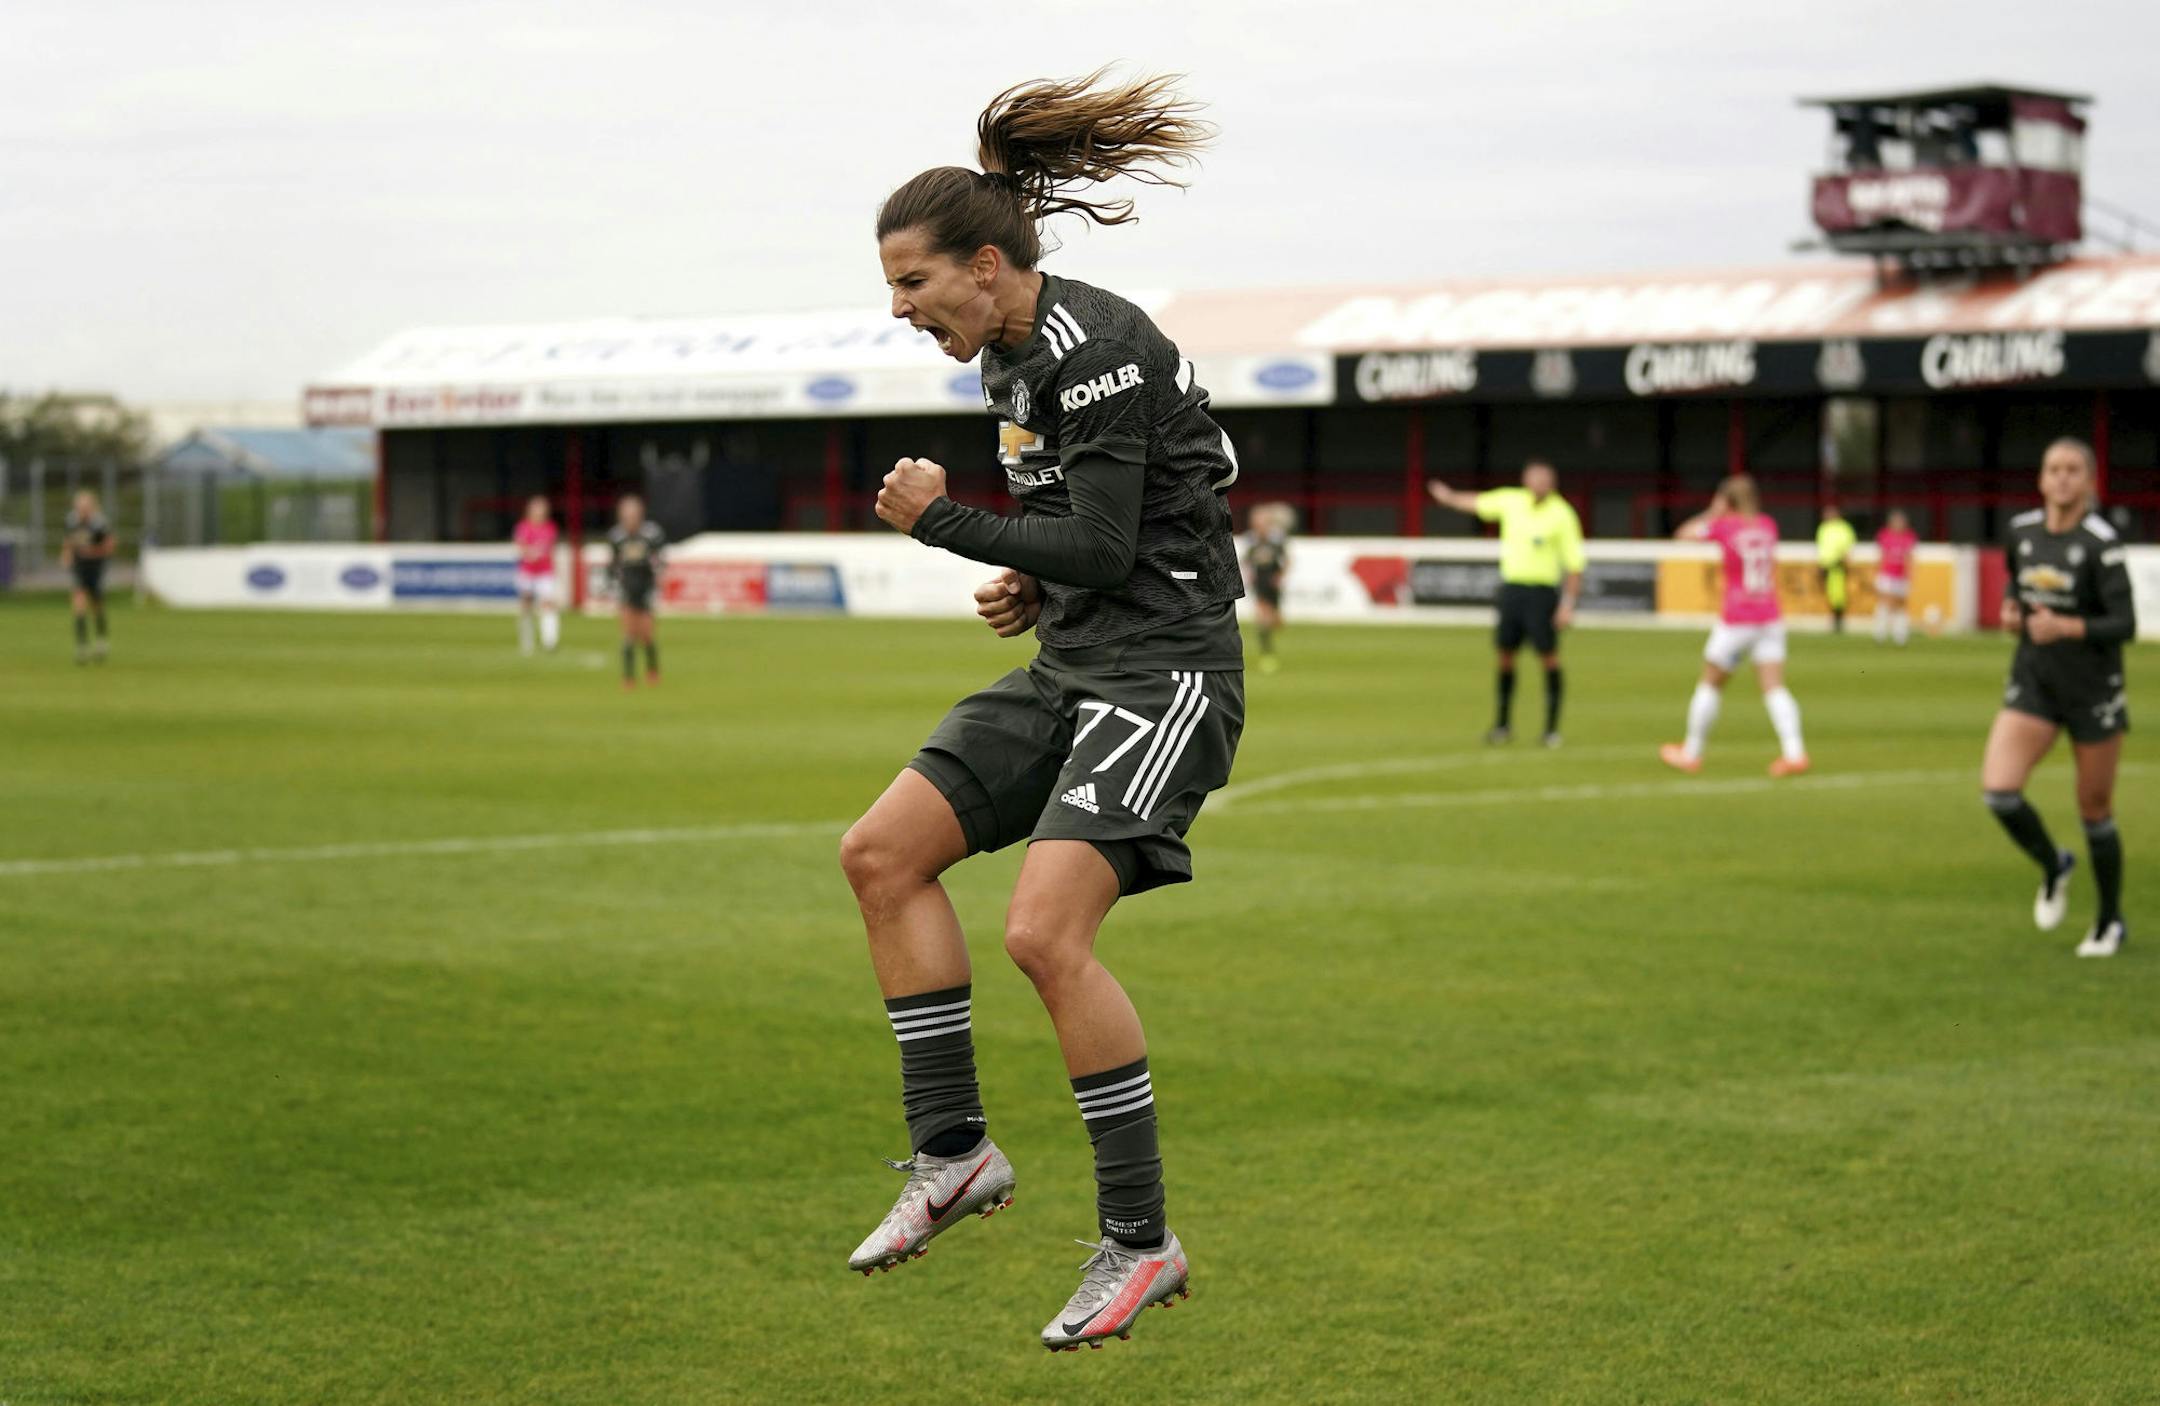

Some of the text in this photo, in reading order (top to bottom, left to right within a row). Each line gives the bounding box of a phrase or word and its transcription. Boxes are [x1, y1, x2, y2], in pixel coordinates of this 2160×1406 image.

[1060, 363, 1144, 413] KOHLER
[1064, 702, 1156, 774] 77
[1060, 793, 1100, 814] adidas
[1106, 1223, 1137, 1235] UNITED
